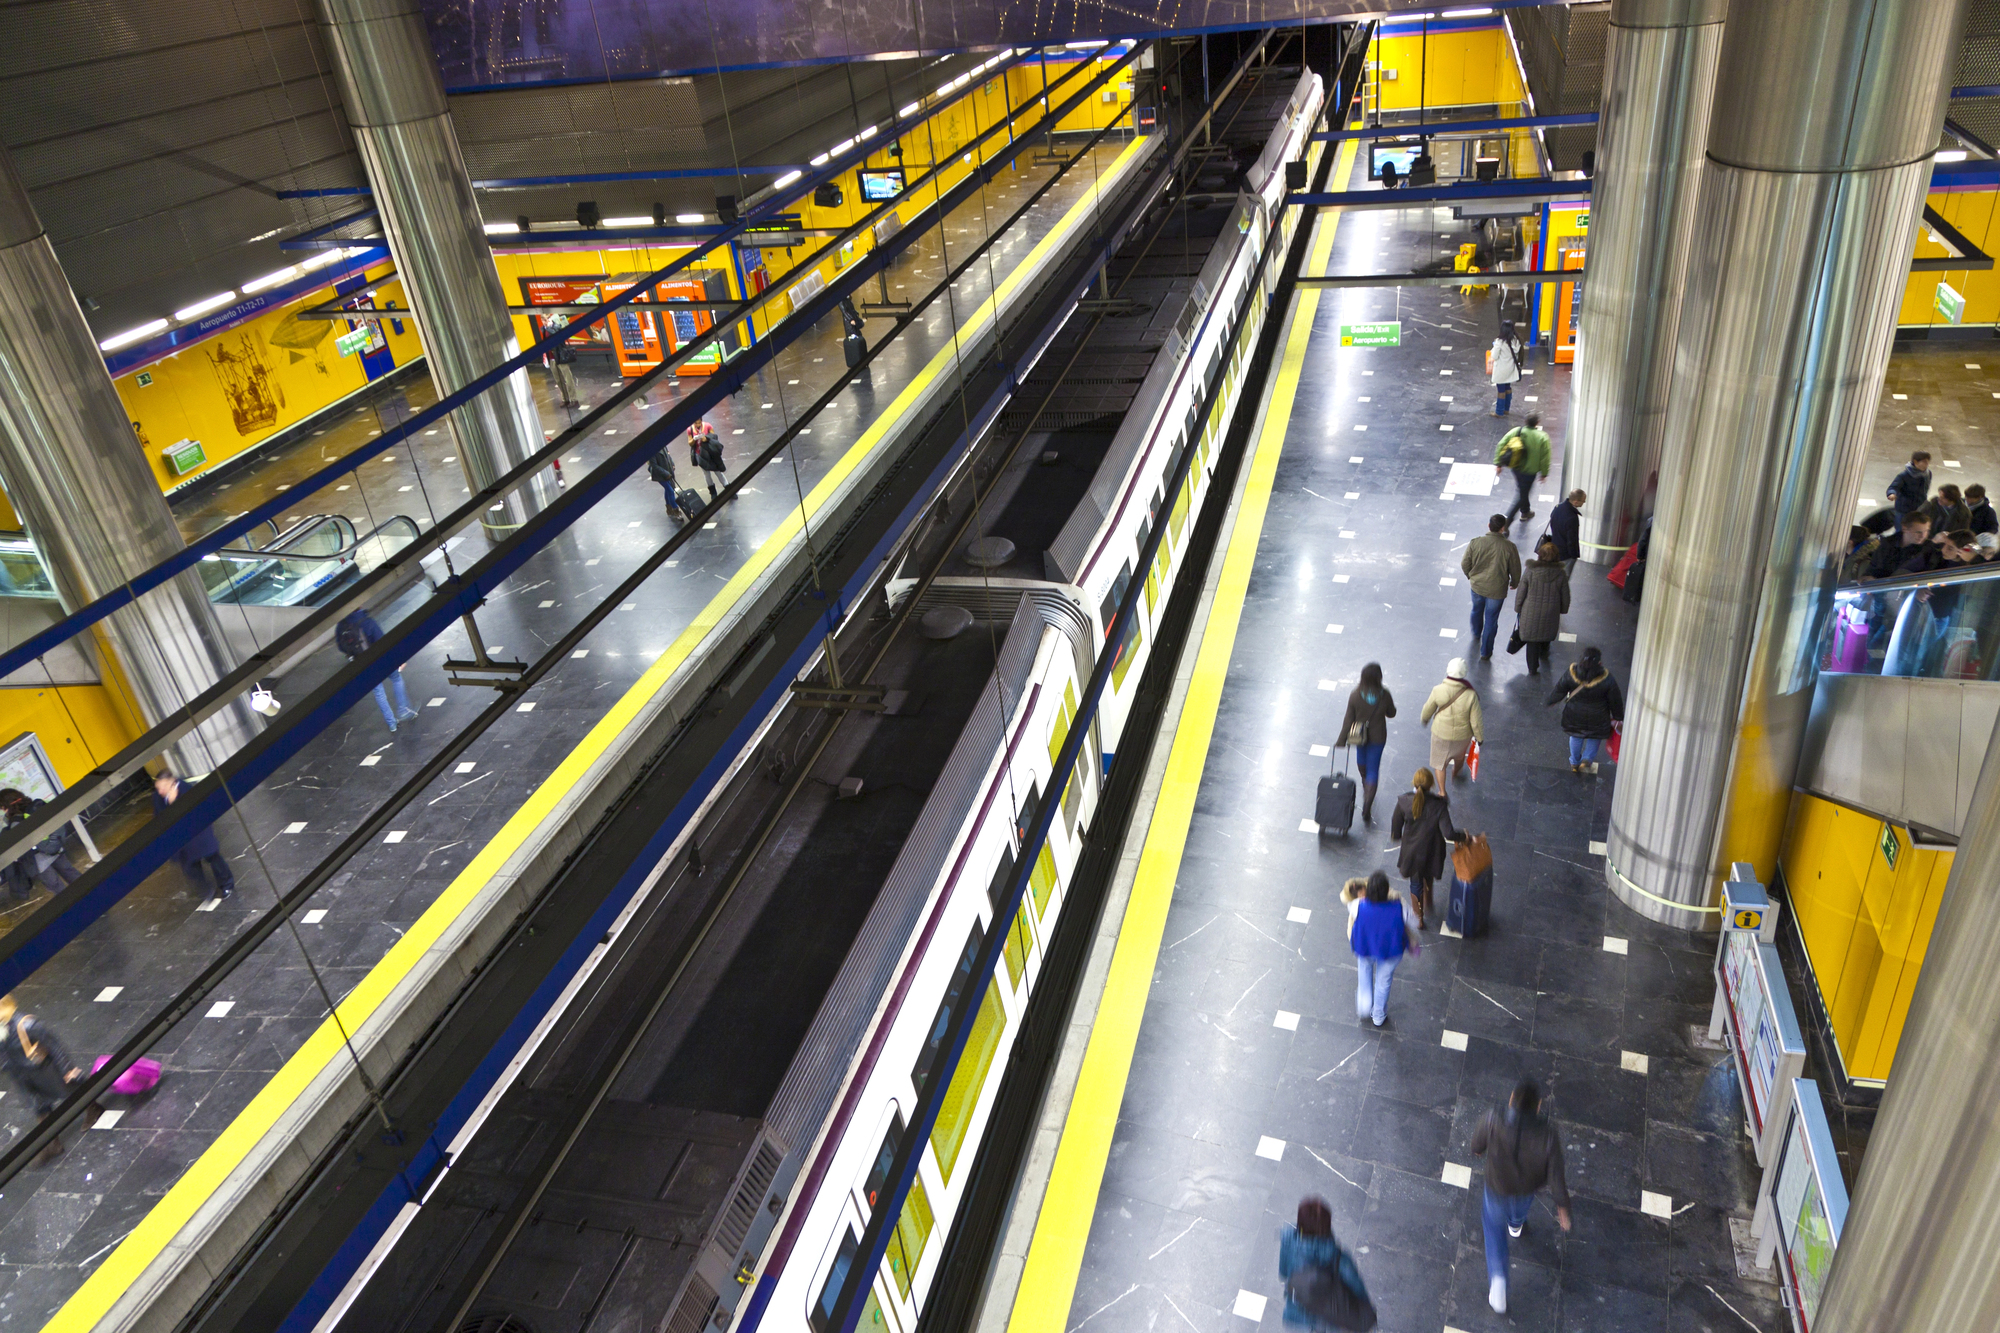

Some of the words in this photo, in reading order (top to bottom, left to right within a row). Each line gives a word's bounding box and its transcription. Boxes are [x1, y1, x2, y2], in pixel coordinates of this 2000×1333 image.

[661, 281, 693, 289] ALIMENTOS
[200, 310, 237, 330] Aeropuerto
[1353, 336, 1388, 344] Aeropuerto
